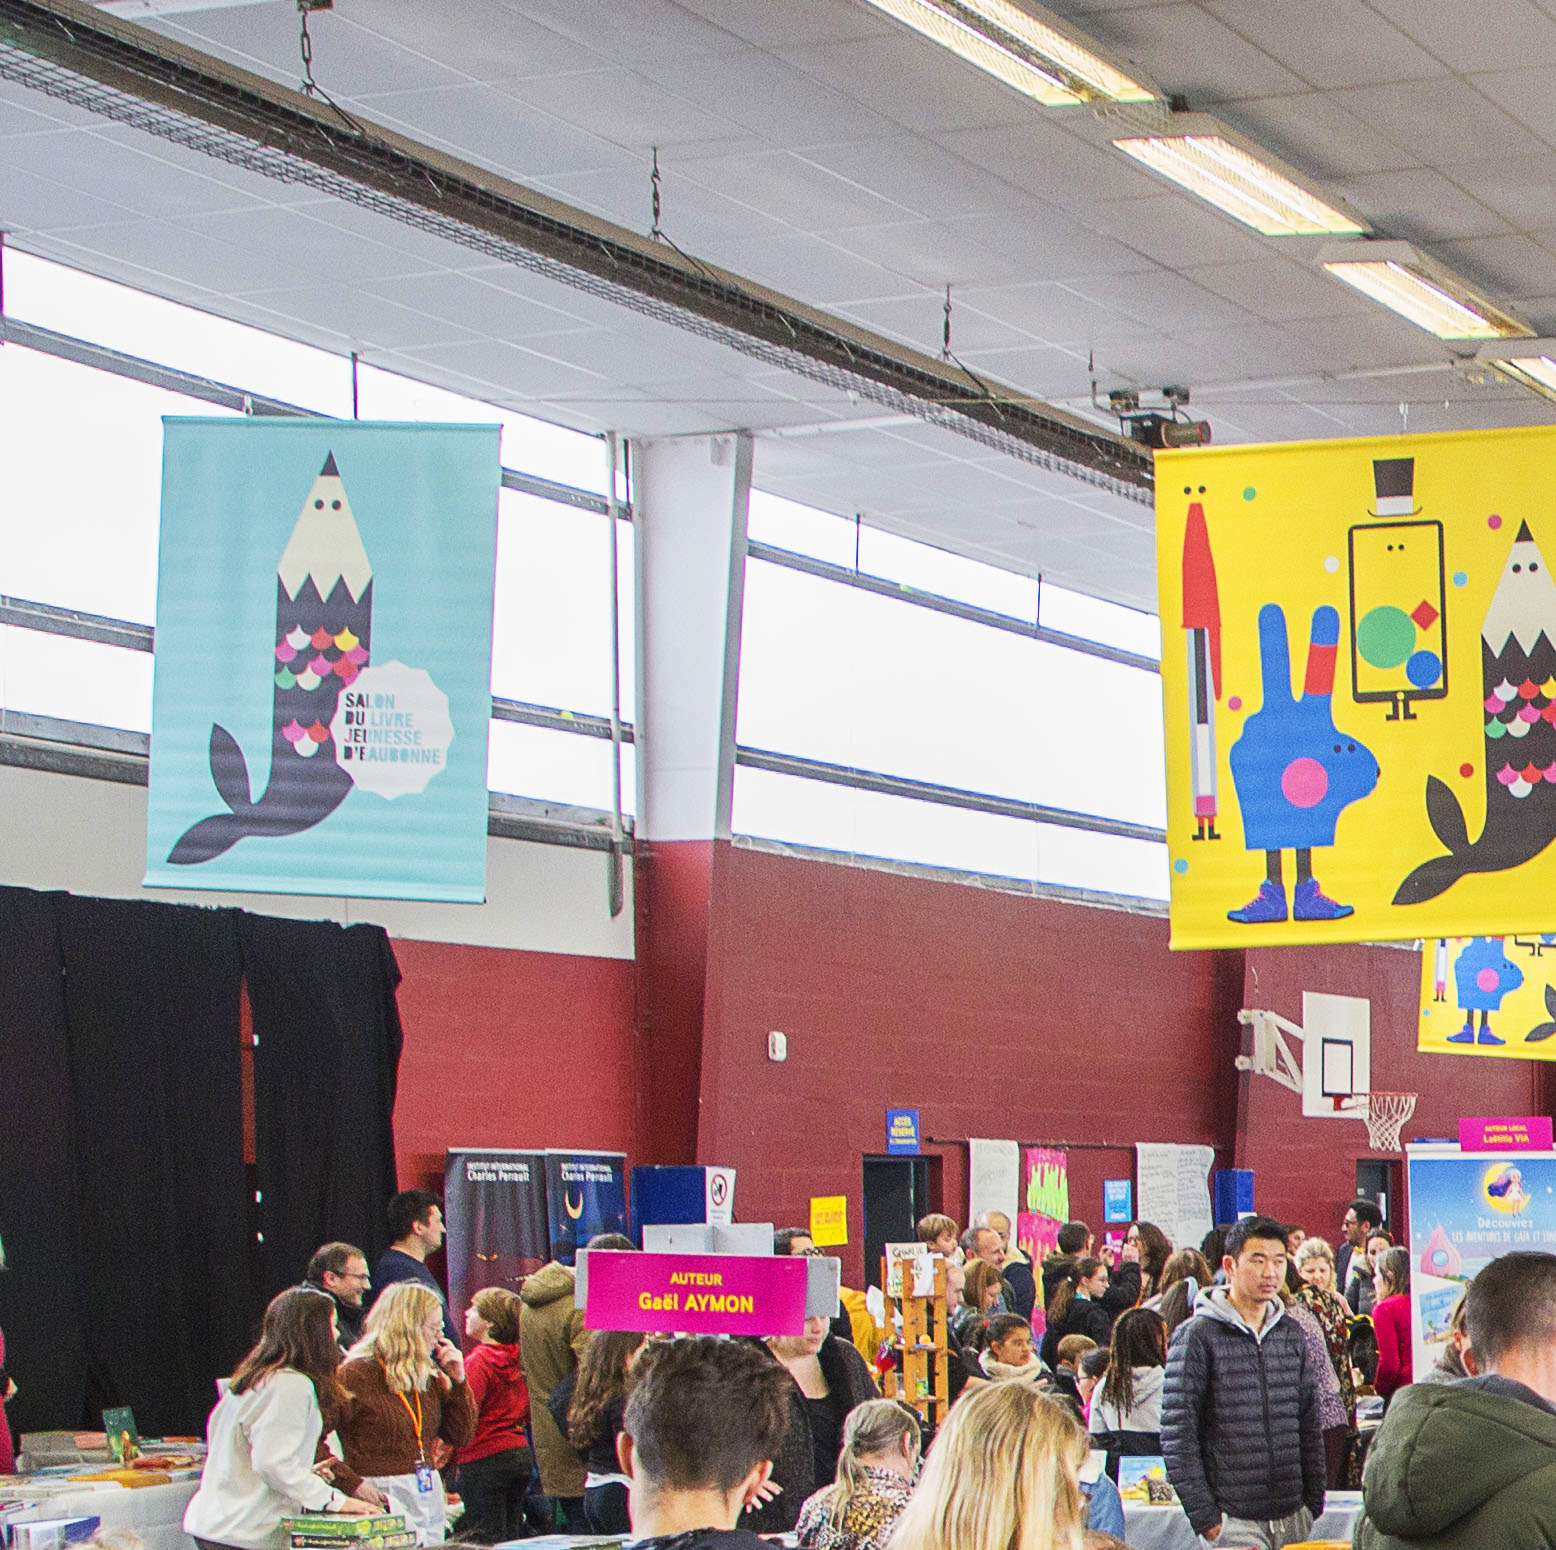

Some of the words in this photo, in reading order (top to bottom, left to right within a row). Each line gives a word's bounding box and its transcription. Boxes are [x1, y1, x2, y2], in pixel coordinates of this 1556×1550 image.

[345, 692, 395, 709] SALON
[345, 710, 365, 726] DU
[371, 711, 415, 728] LIVRE
[344, 728, 421, 745] JEUNESSE
[344, 746, 440, 765] D'EAUBONNE
[670, 1272, 723, 1286] AUTEUR
[638, 1291, 679, 1311] Gaël
[684, 1293, 754, 1313] AYMON
